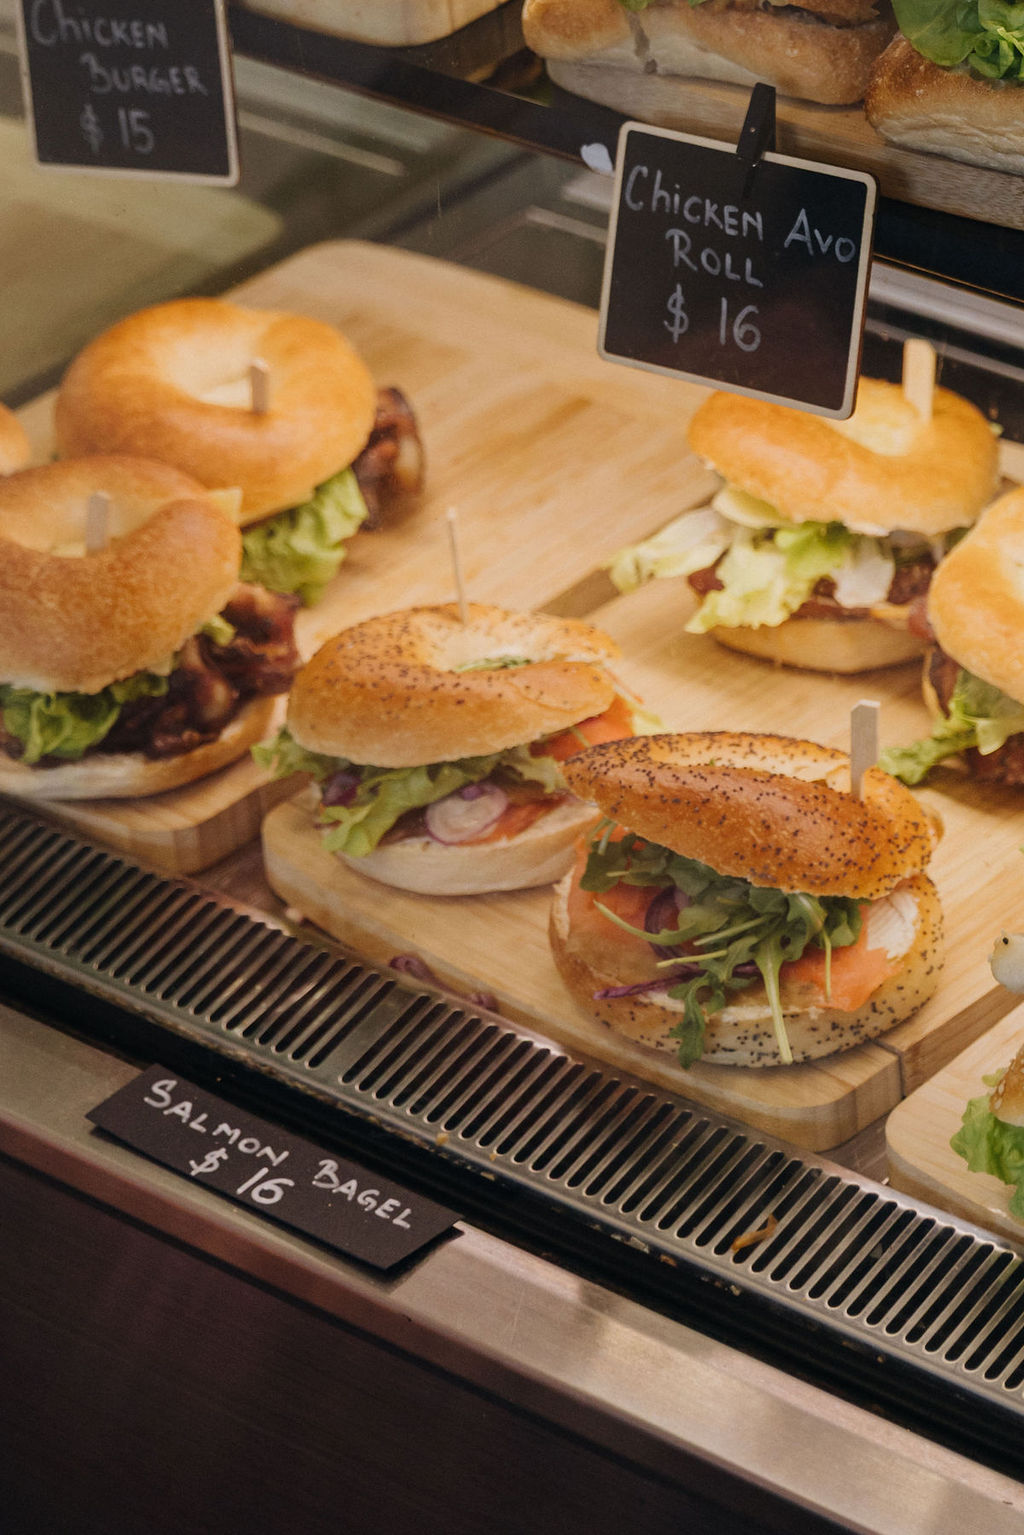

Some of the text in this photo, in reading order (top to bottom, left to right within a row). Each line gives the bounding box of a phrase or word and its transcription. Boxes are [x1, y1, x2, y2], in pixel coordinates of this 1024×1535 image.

[80, 103, 155, 155] $ 15
[665, 229, 763, 288] ROLL
[664, 283, 761, 352] $ 16
[143, 1078, 411, 1230] SALMON BAGEL
[189, 1147, 295, 1205] $ 16
